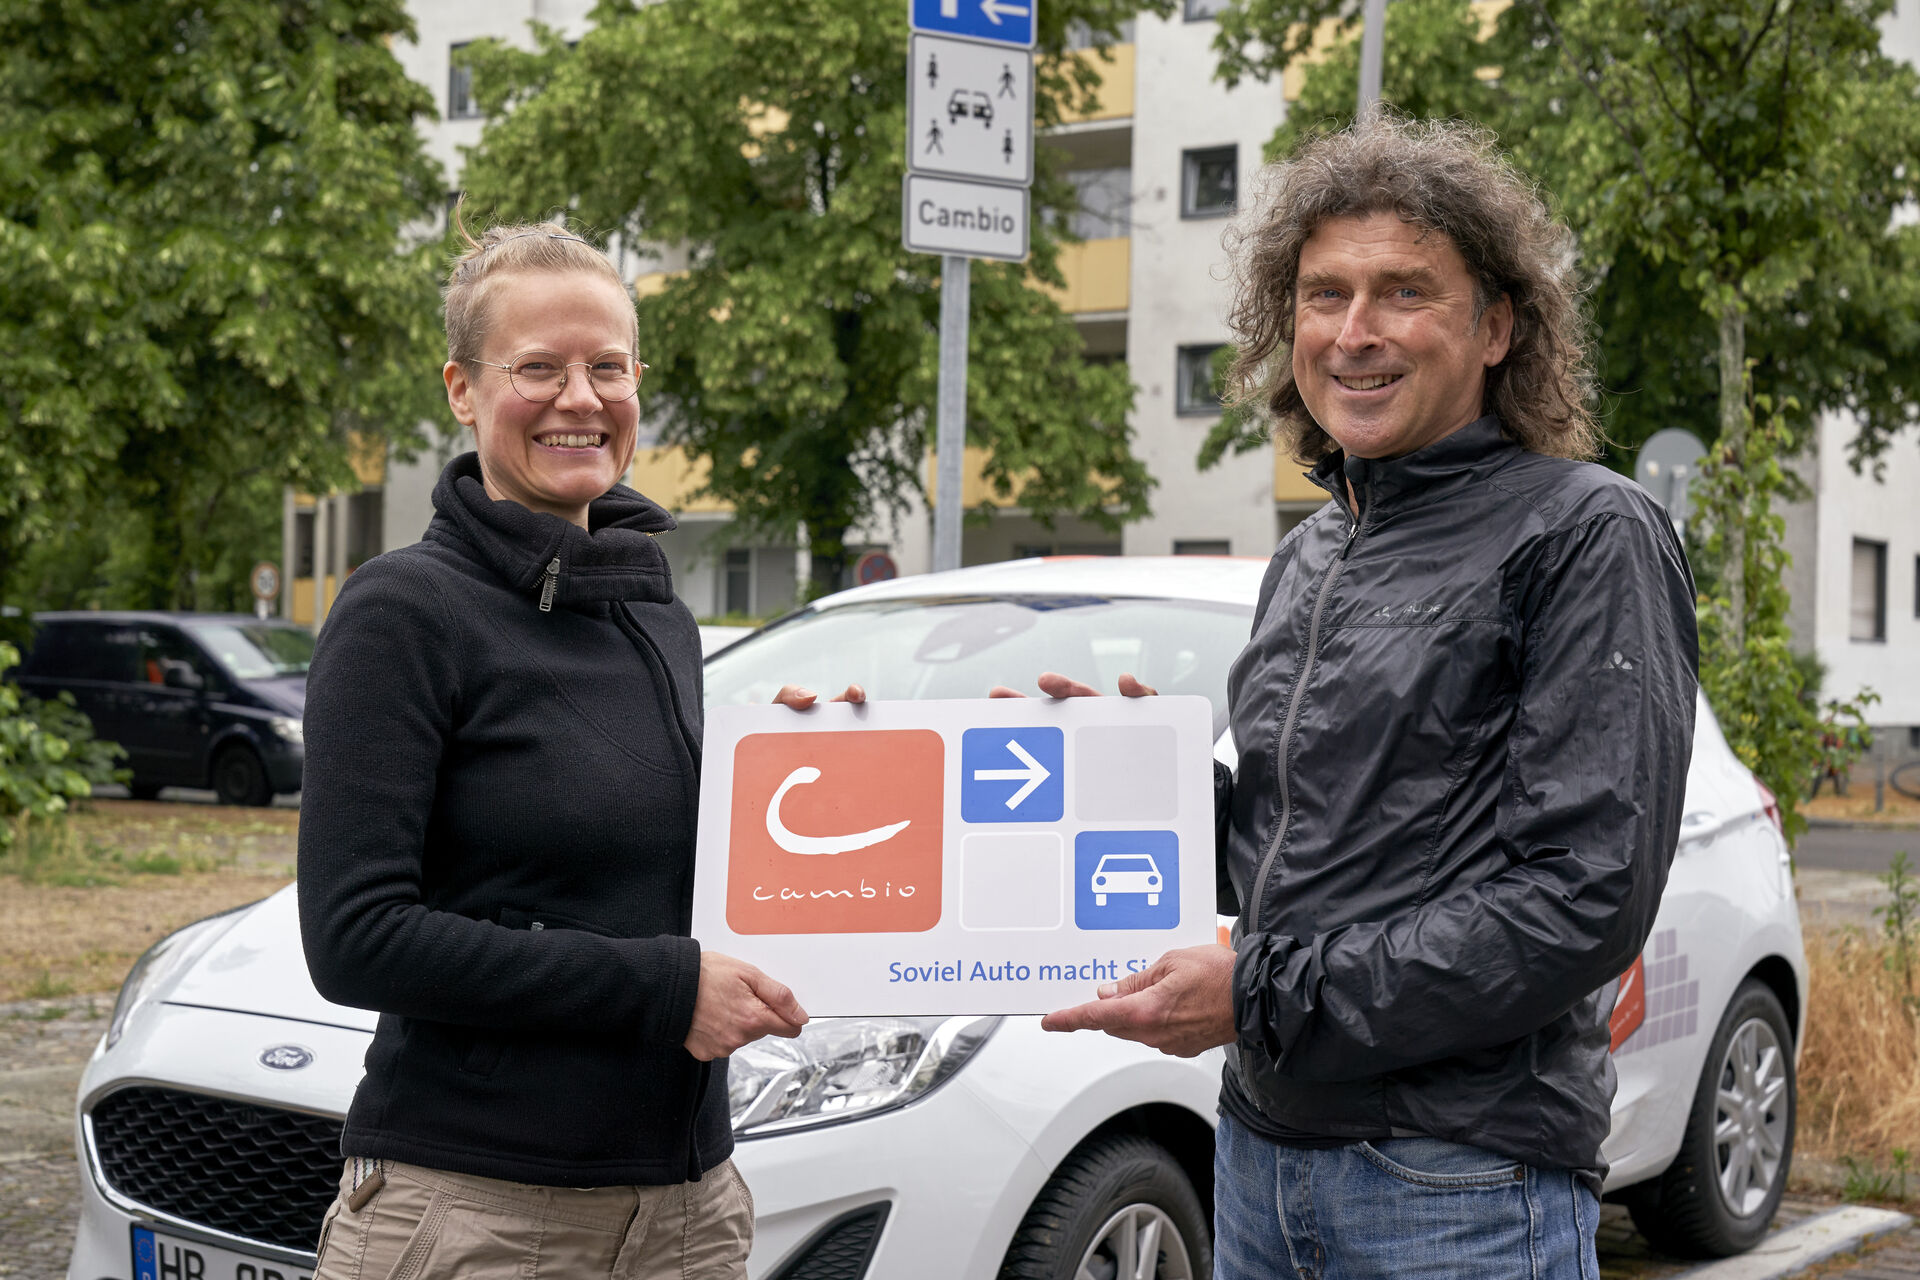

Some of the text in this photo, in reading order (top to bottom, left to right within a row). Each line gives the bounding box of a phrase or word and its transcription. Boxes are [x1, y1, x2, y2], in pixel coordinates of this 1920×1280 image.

[918, 199, 1015, 234] Cambio
[752, 878, 916, 901] cambio
[889, 960, 962, 983] Soviel
[969, 961, 1031, 982] Auto
[1039, 959, 1118, 981] macht
